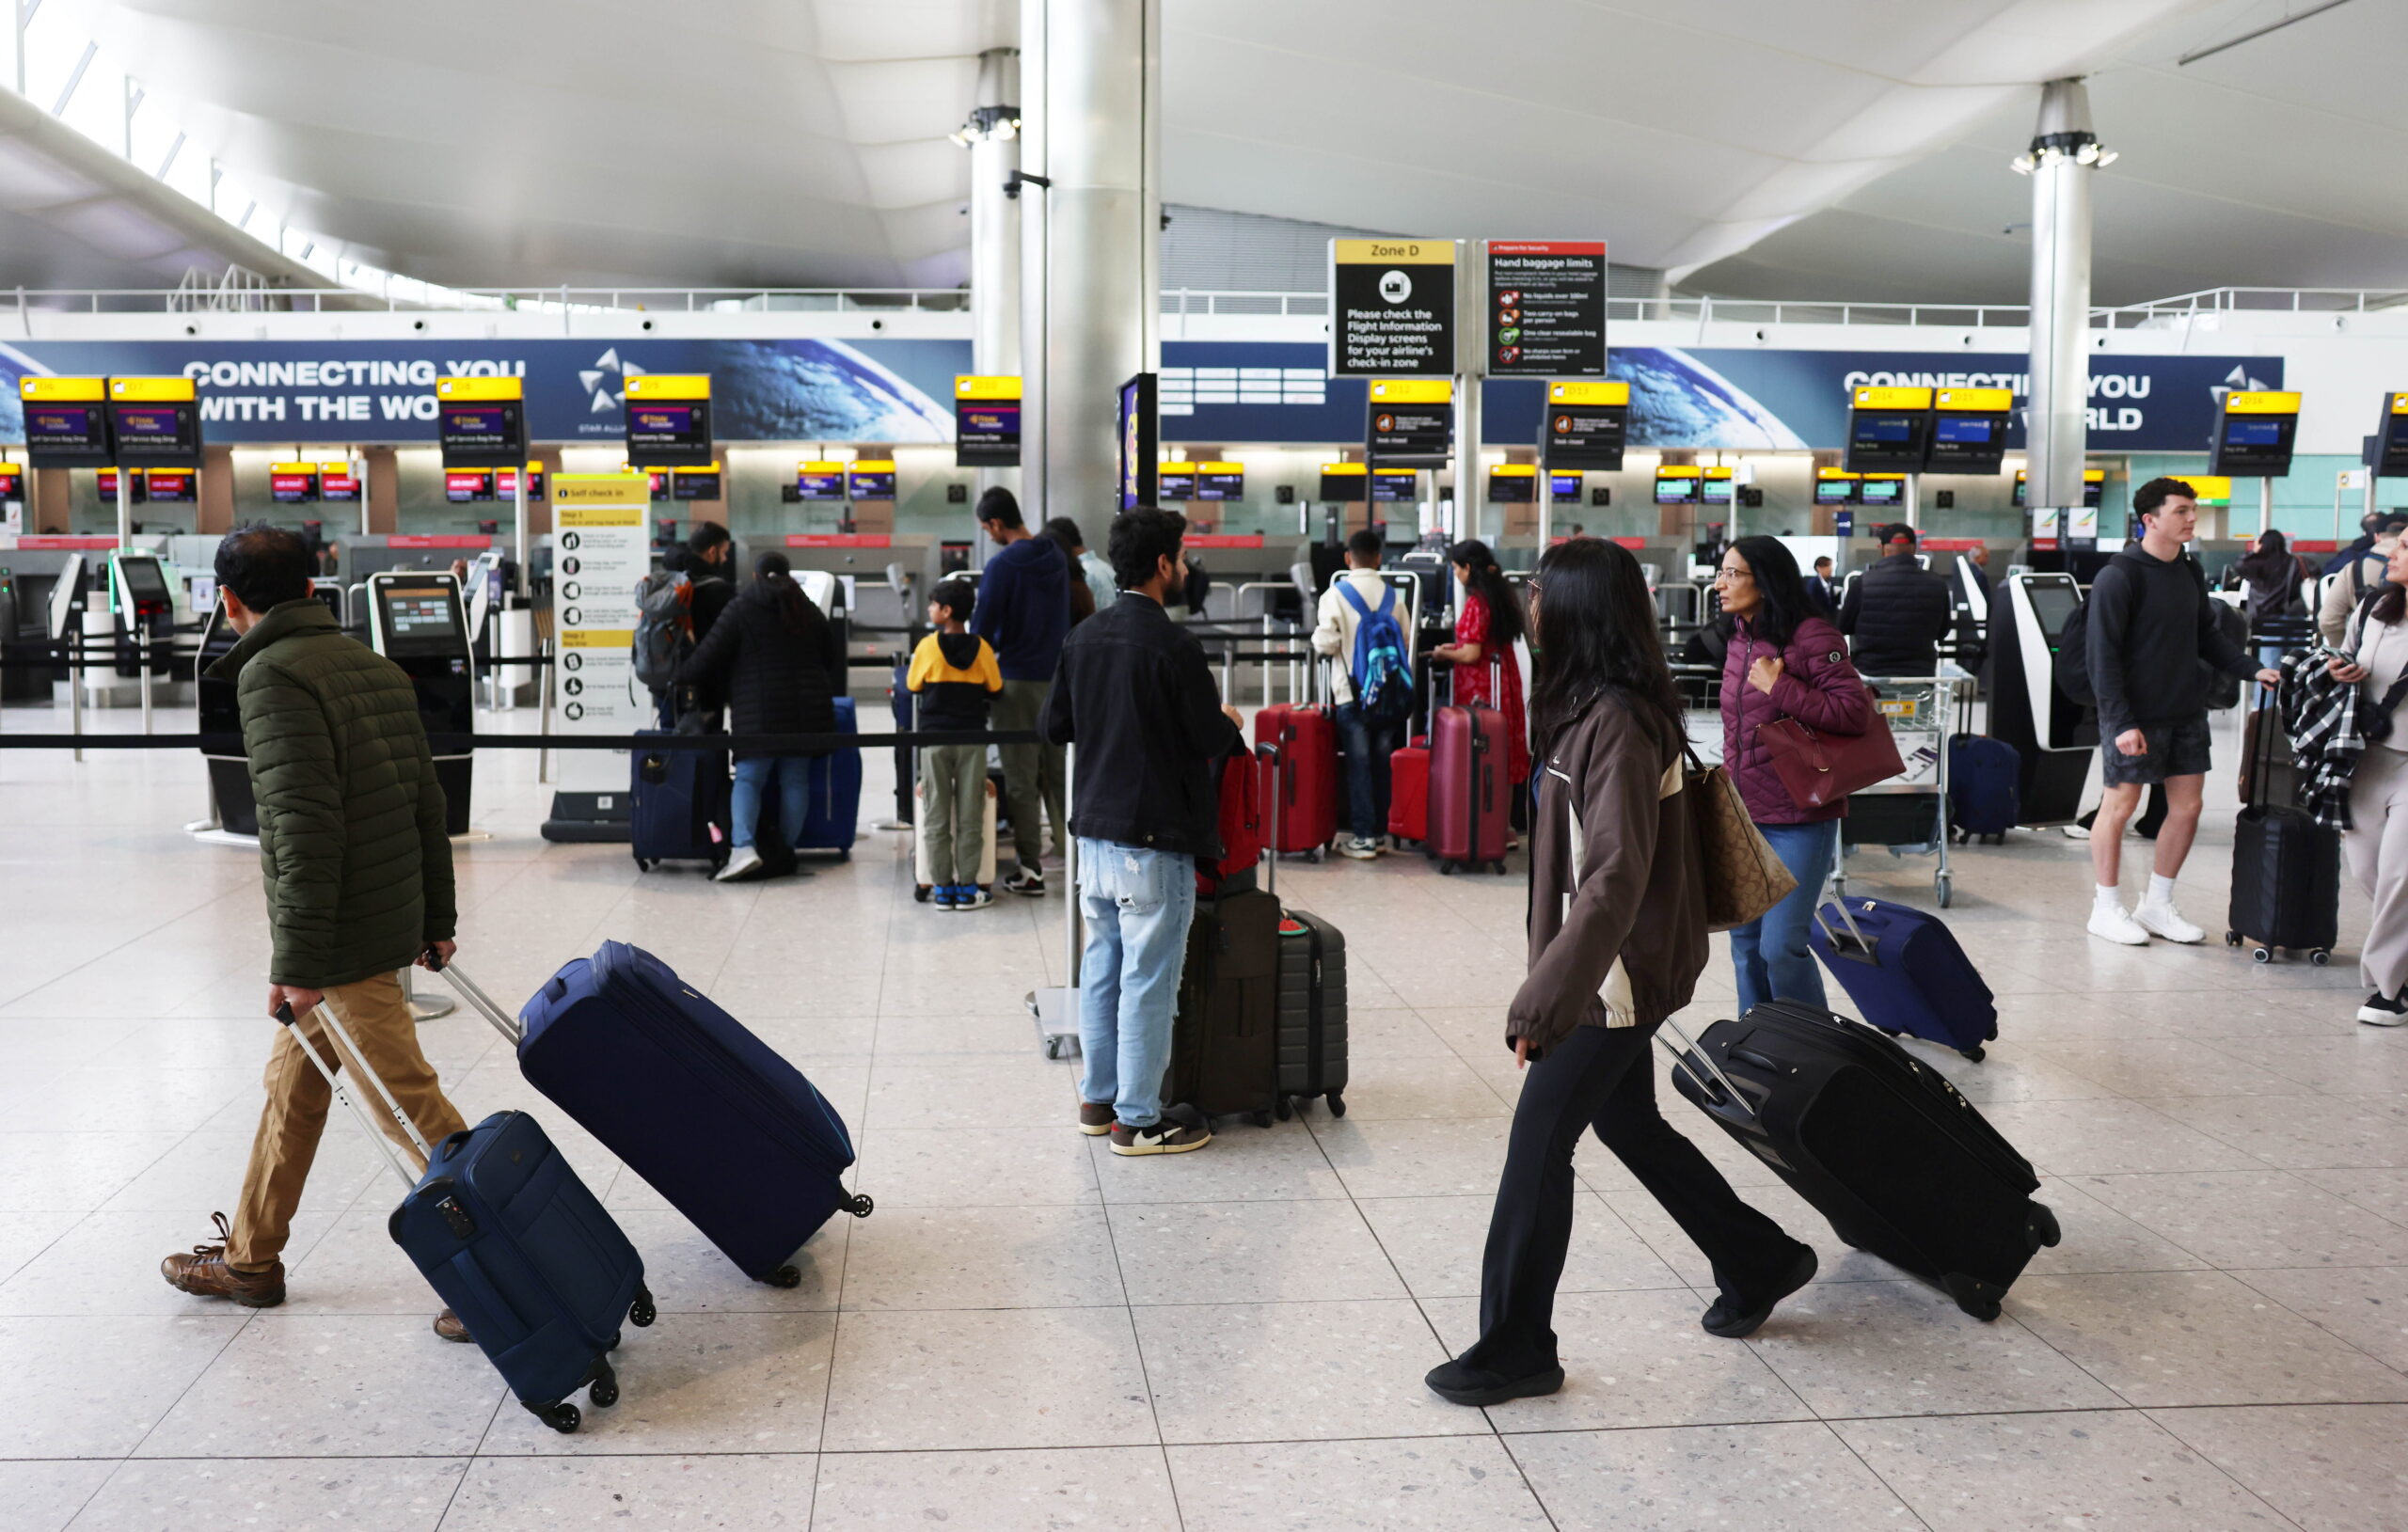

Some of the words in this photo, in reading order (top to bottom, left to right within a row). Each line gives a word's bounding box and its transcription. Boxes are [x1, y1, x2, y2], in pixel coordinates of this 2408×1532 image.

[1371, 245, 1405, 256] Zone
[1409, 245, 1420, 256] D
[1495, 258, 1521, 267] Hand
[1523, 258, 1565, 269] baggage
[1566, 258, 1593, 267] limits
[1347, 308, 1382, 319] Please
[1383, 308, 1413, 319] check
[1414, 308, 1433, 319] the
[1347, 321, 1378, 333] Flight
[1379, 321, 1442, 331] Information
[1347, 333, 1386, 345] Display
[1388, 335, 1428, 343] screens
[1347, 345, 1364, 355] for
[1365, 347, 1390, 357] your
[1391, 345, 1434, 355] airline's
[1347, 357, 1391, 368] check-in
[1392, 359, 1419, 368] zone
[182, 360, 436, 387] CONNECTING
[446, 360, 526, 377] YOU
[1844, 371, 2030, 396] CONNECTI
[2086, 374, 2151, 398] YOU
[1568, 386, 1590, 395] D13
[199, 396, 286, 421] WITH
[294, 395, 372, 420] THE
[571, 489, 587, 498] Self
[589, 489, 612, 498] check
[615, 489, 625, 498] in
